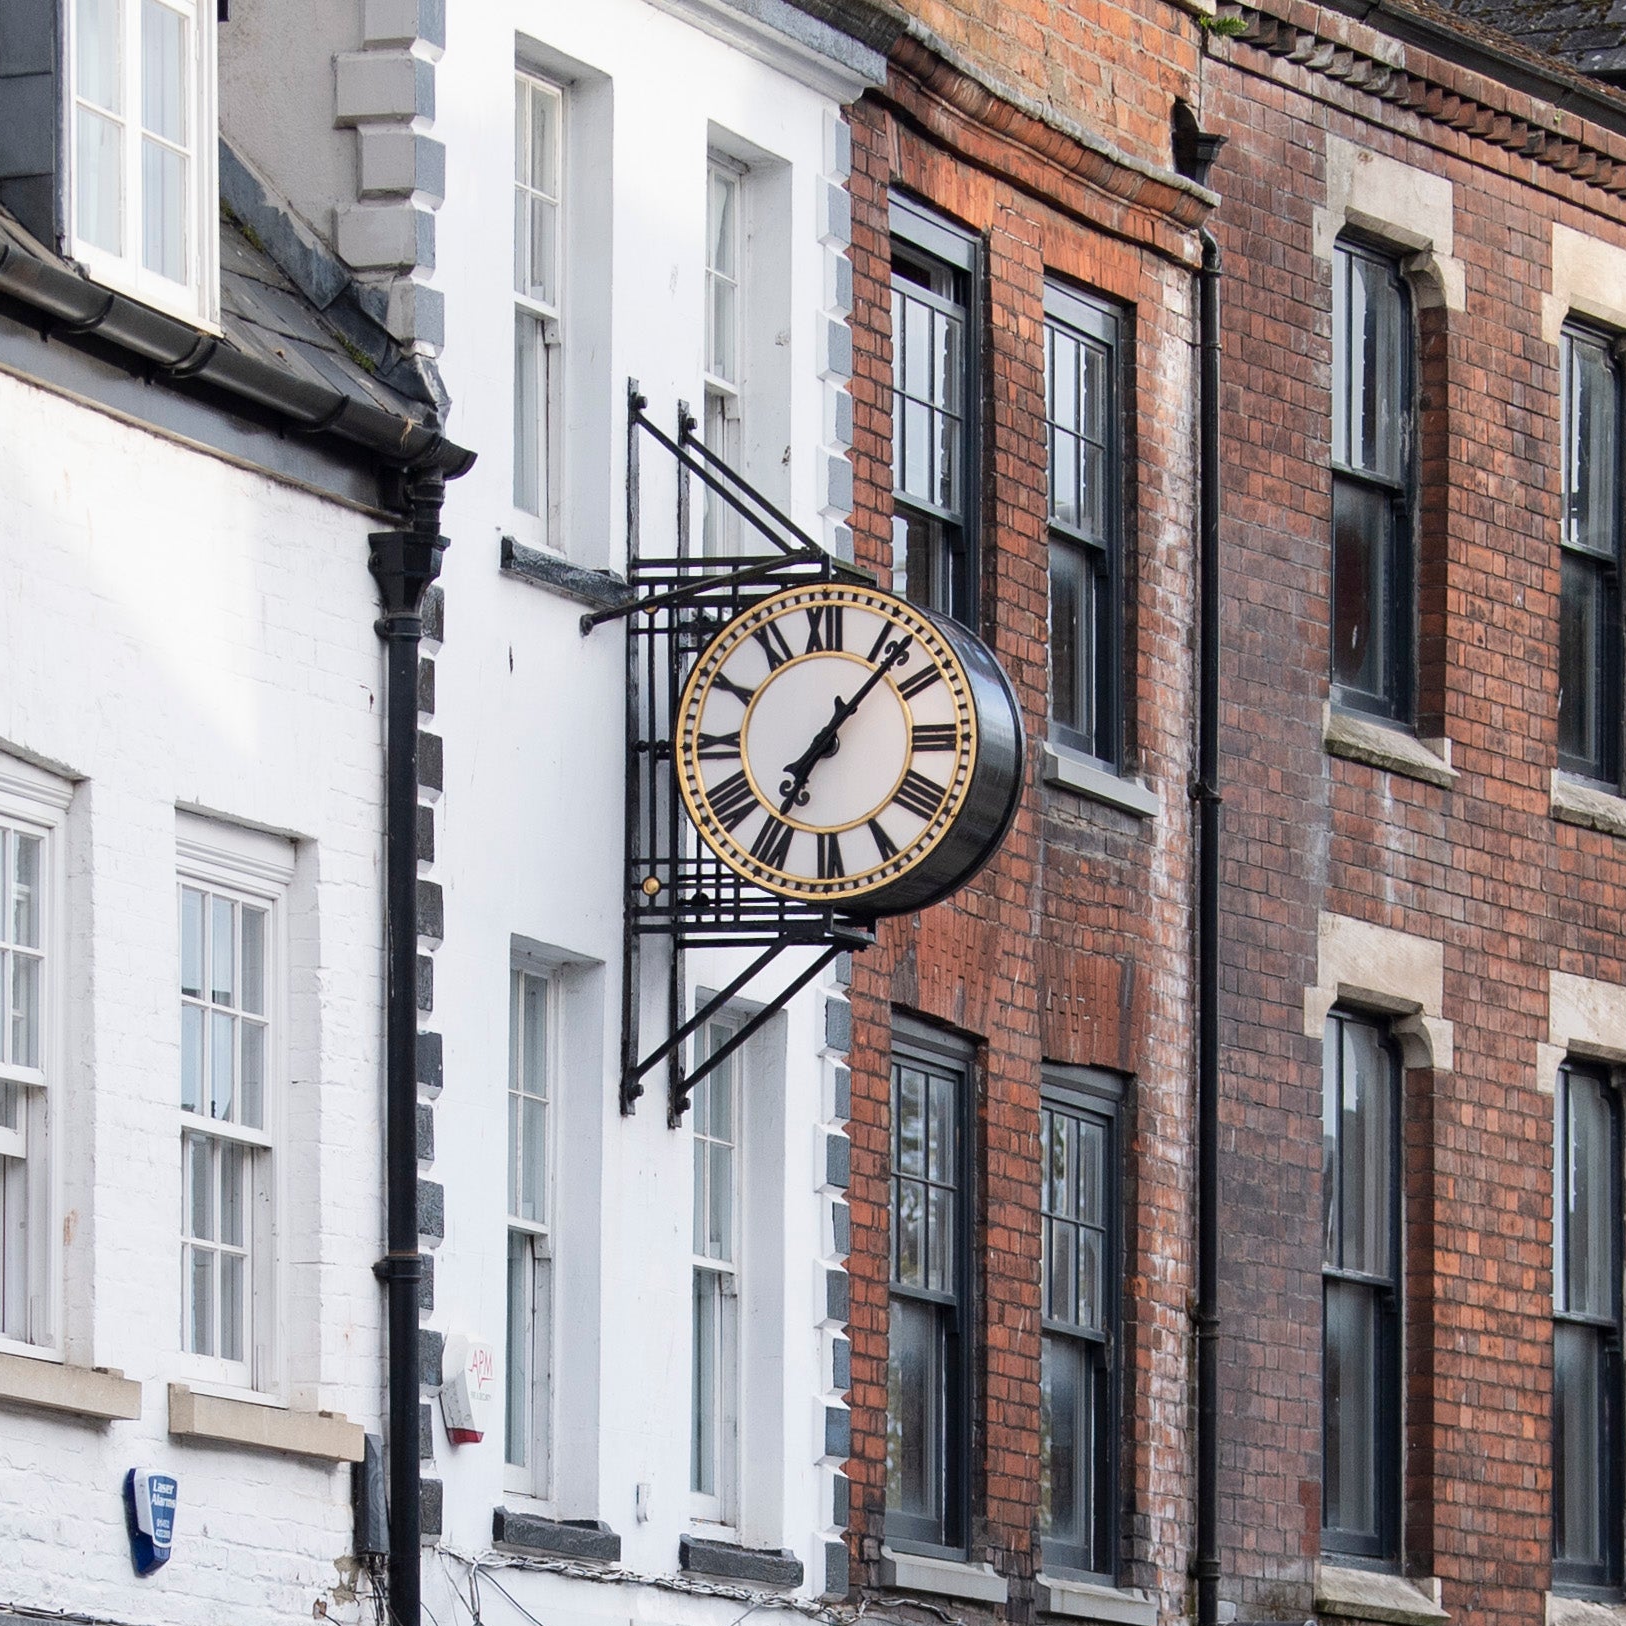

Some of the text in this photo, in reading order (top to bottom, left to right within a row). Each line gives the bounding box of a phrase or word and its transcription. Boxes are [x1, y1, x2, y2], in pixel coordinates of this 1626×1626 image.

[469, 1349, 494, 1389] APM
[153, 1478, 175, 1496] Laser
[151, 1493, 176, 1509] Alarms
